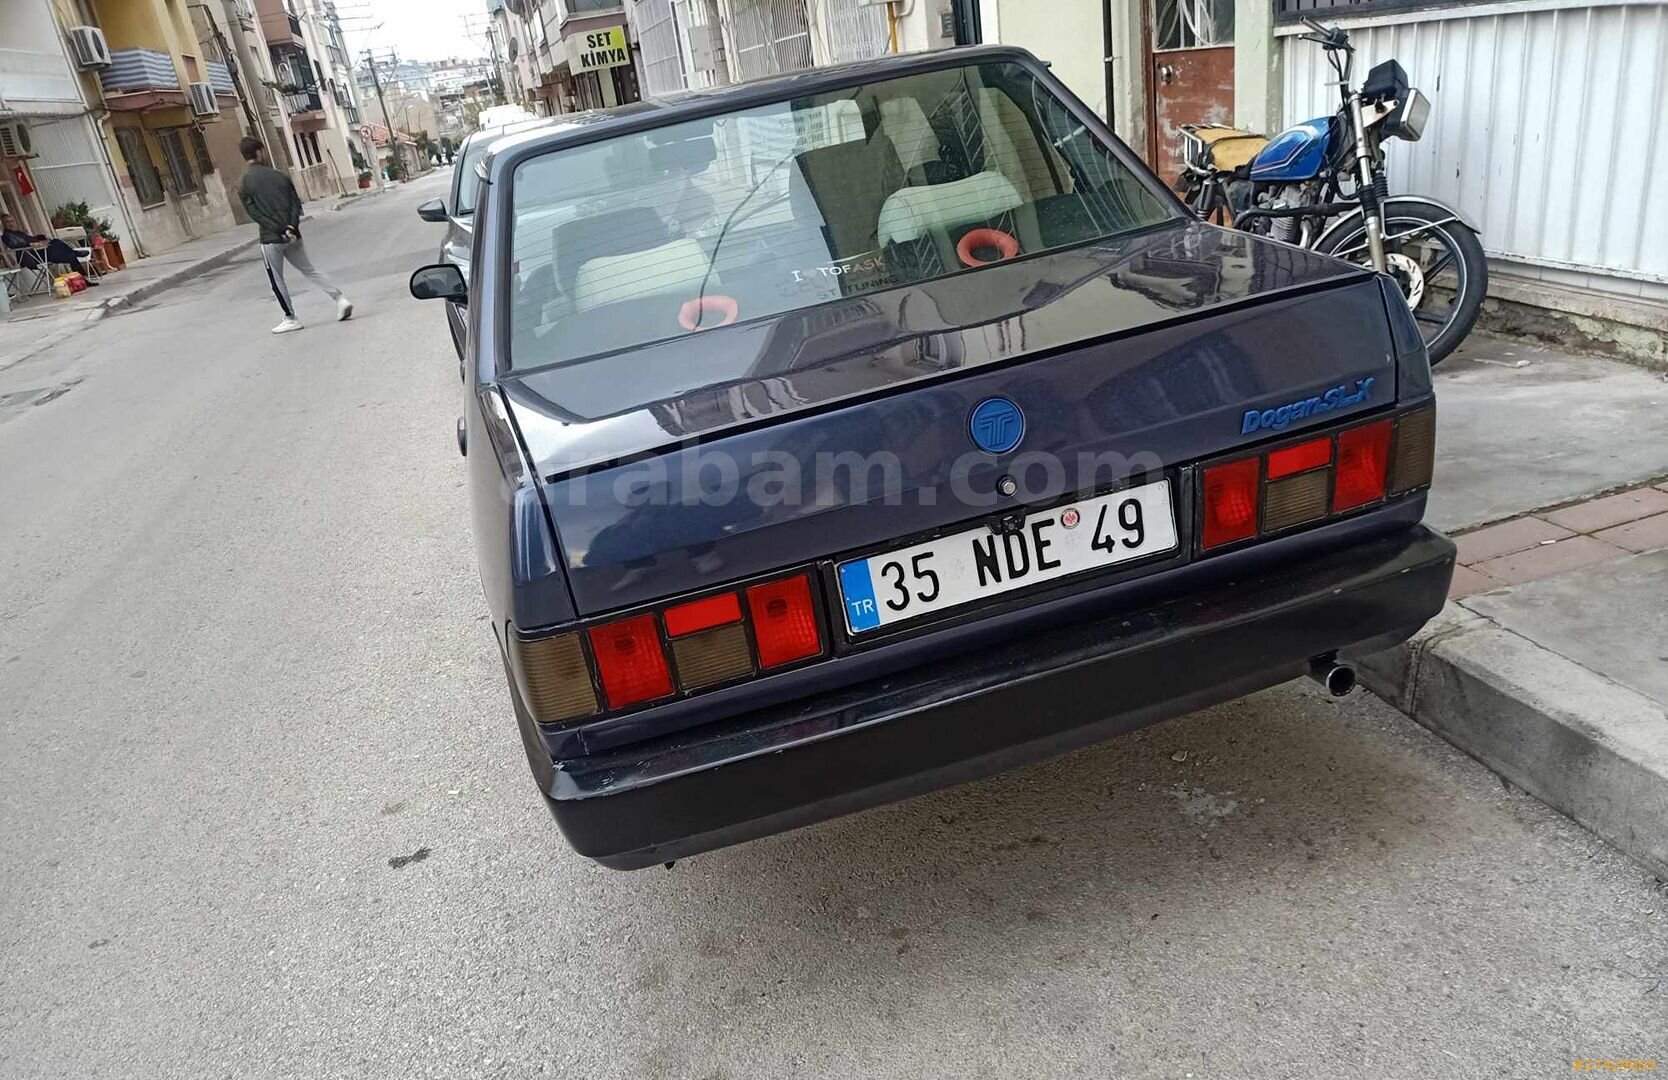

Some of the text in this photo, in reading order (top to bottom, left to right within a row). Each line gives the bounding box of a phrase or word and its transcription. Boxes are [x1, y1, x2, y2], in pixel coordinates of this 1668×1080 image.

[587, 32, 611, 48] SET
[581, 48, 626, 67] KİMYA
[881, 498, 1145, 611] 35 NDE 49
[851, 598, 875, 617] TR
